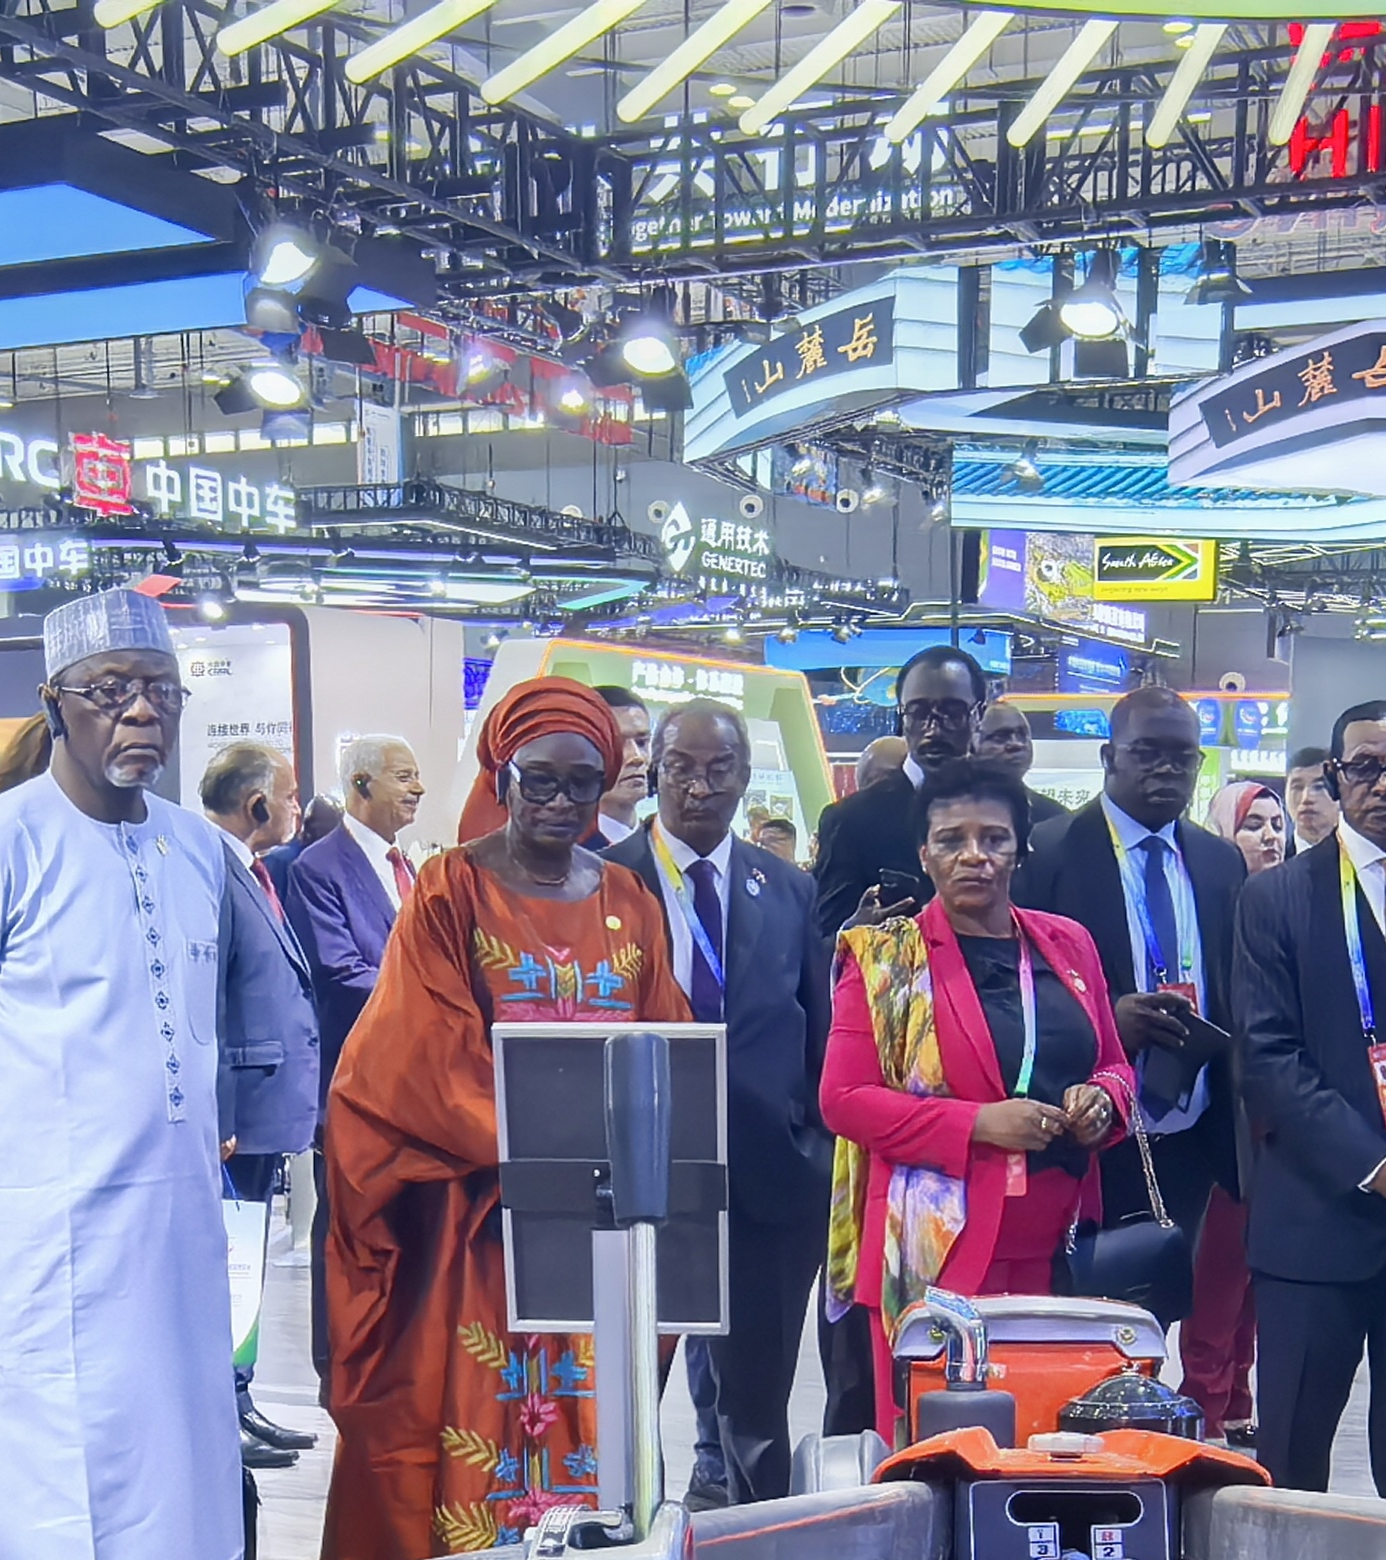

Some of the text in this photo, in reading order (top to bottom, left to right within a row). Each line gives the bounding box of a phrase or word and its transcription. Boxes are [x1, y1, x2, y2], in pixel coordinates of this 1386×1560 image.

[145, 458, 298, 534] 中国中车
[701, 551, 767, 580] GENERTEC
[1102, 1546, 1115, 1558] 2
